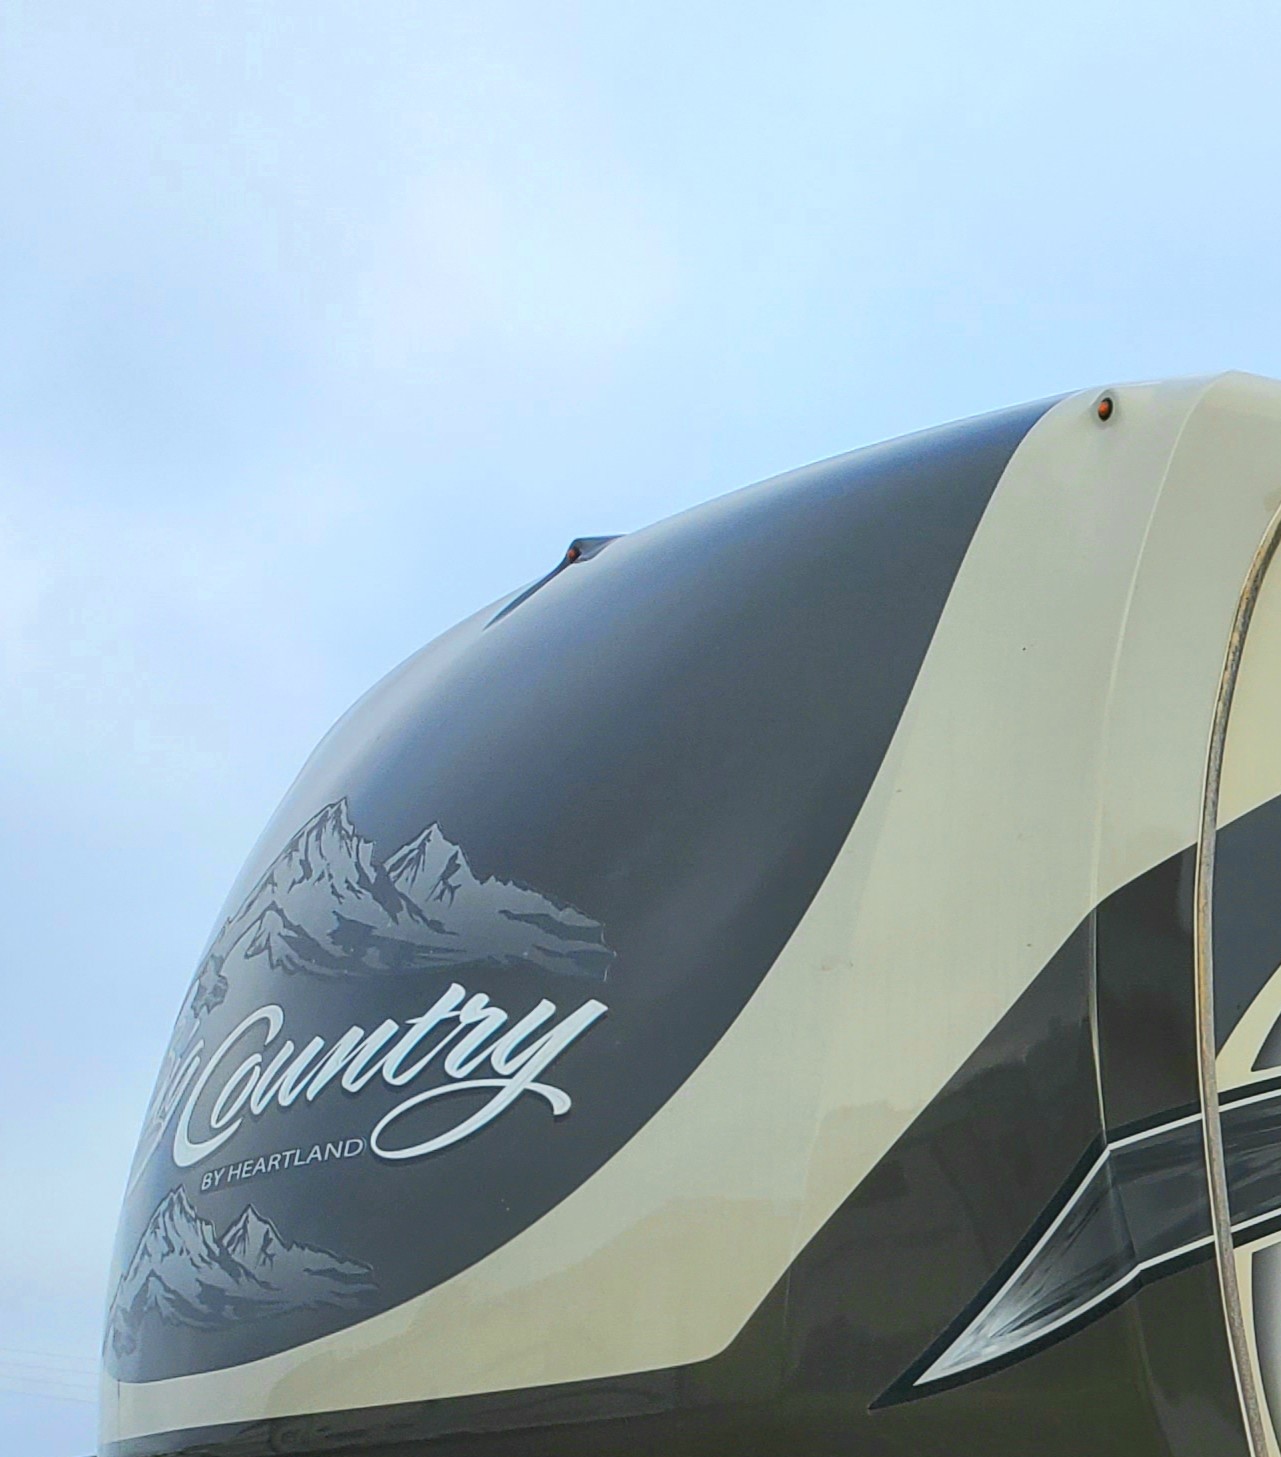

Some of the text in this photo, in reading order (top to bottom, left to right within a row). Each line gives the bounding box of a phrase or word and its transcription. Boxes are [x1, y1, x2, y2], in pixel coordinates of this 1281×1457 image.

[172, 982, 609, 1168] Country
[201, 1138, 364, 1192] BY HEARTLAND
